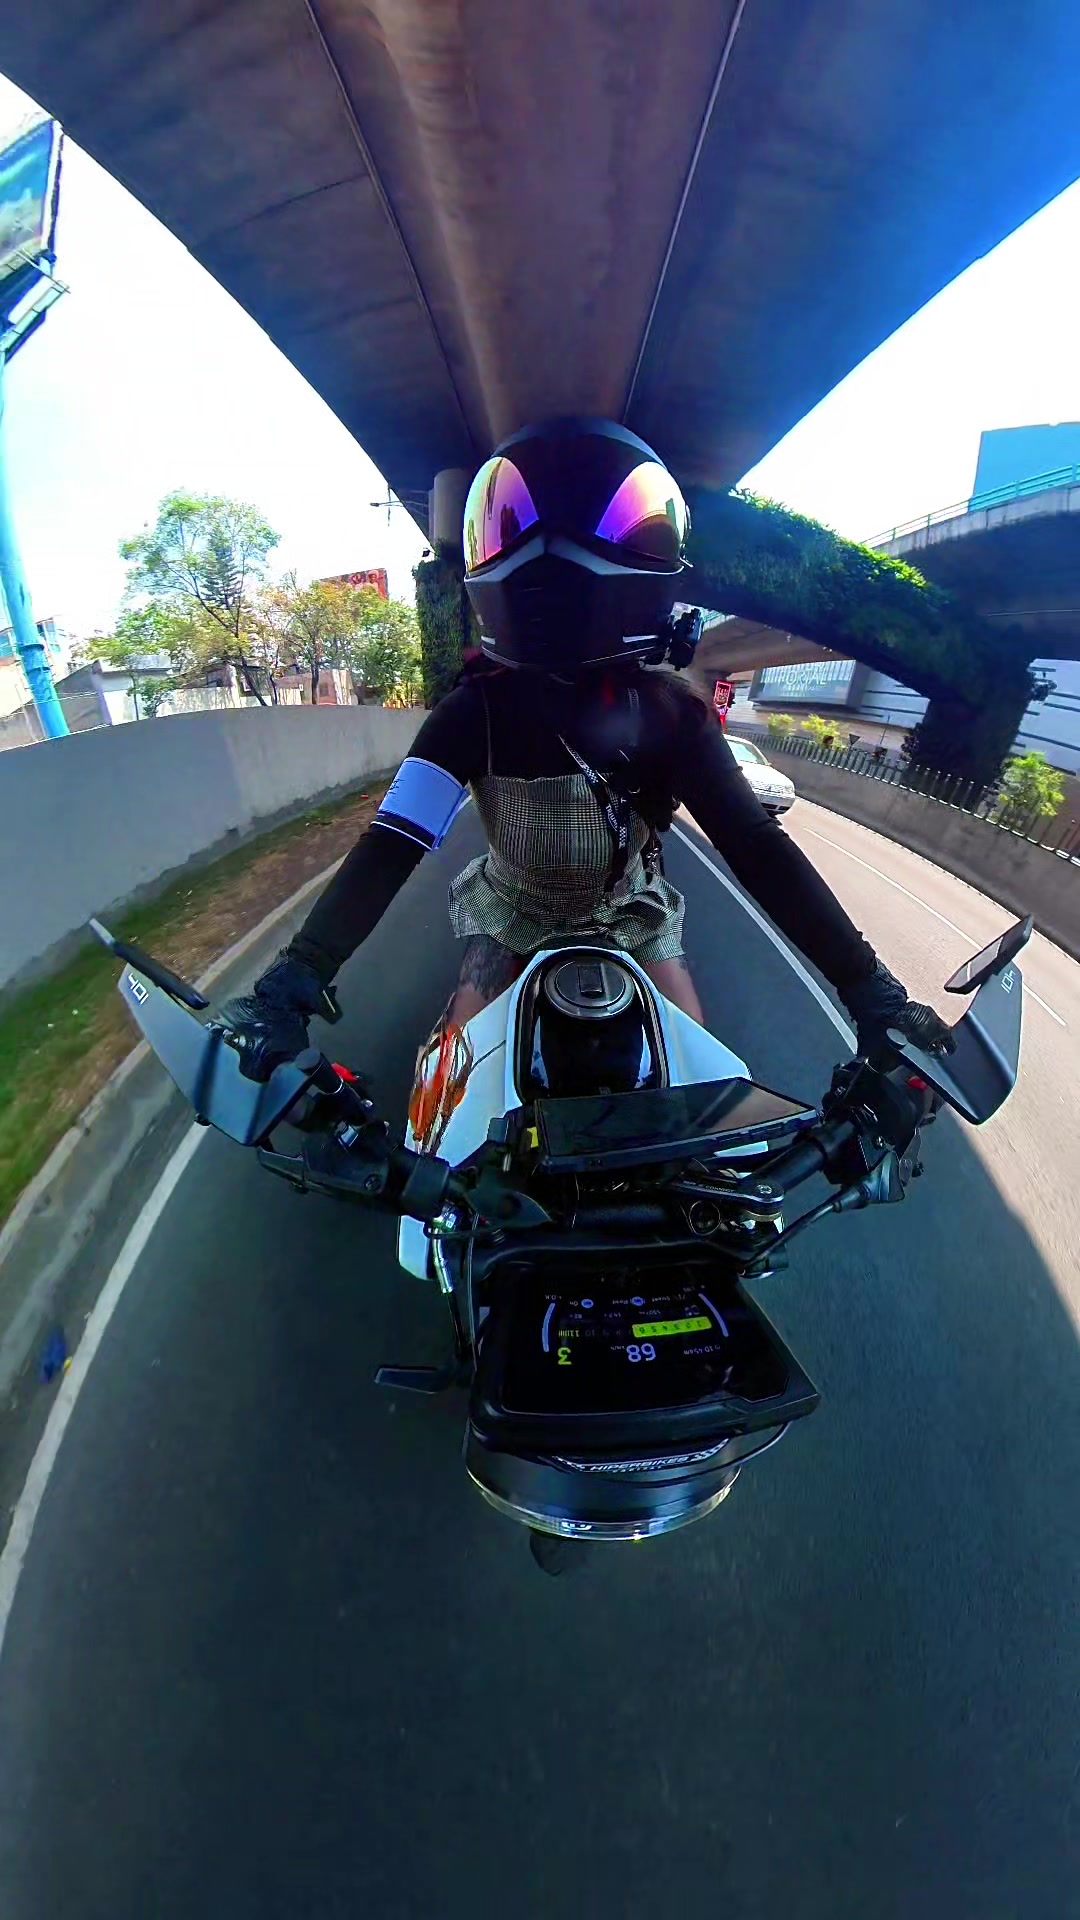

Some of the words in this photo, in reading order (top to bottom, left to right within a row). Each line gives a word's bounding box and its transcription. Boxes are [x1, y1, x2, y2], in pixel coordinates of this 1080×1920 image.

[128, 973, 149, 1004] 401
[1001, 970, 1016, 994] 401
[557, 1347, 573, 1365] 3
[626, 1343, 657, 1363] 68
